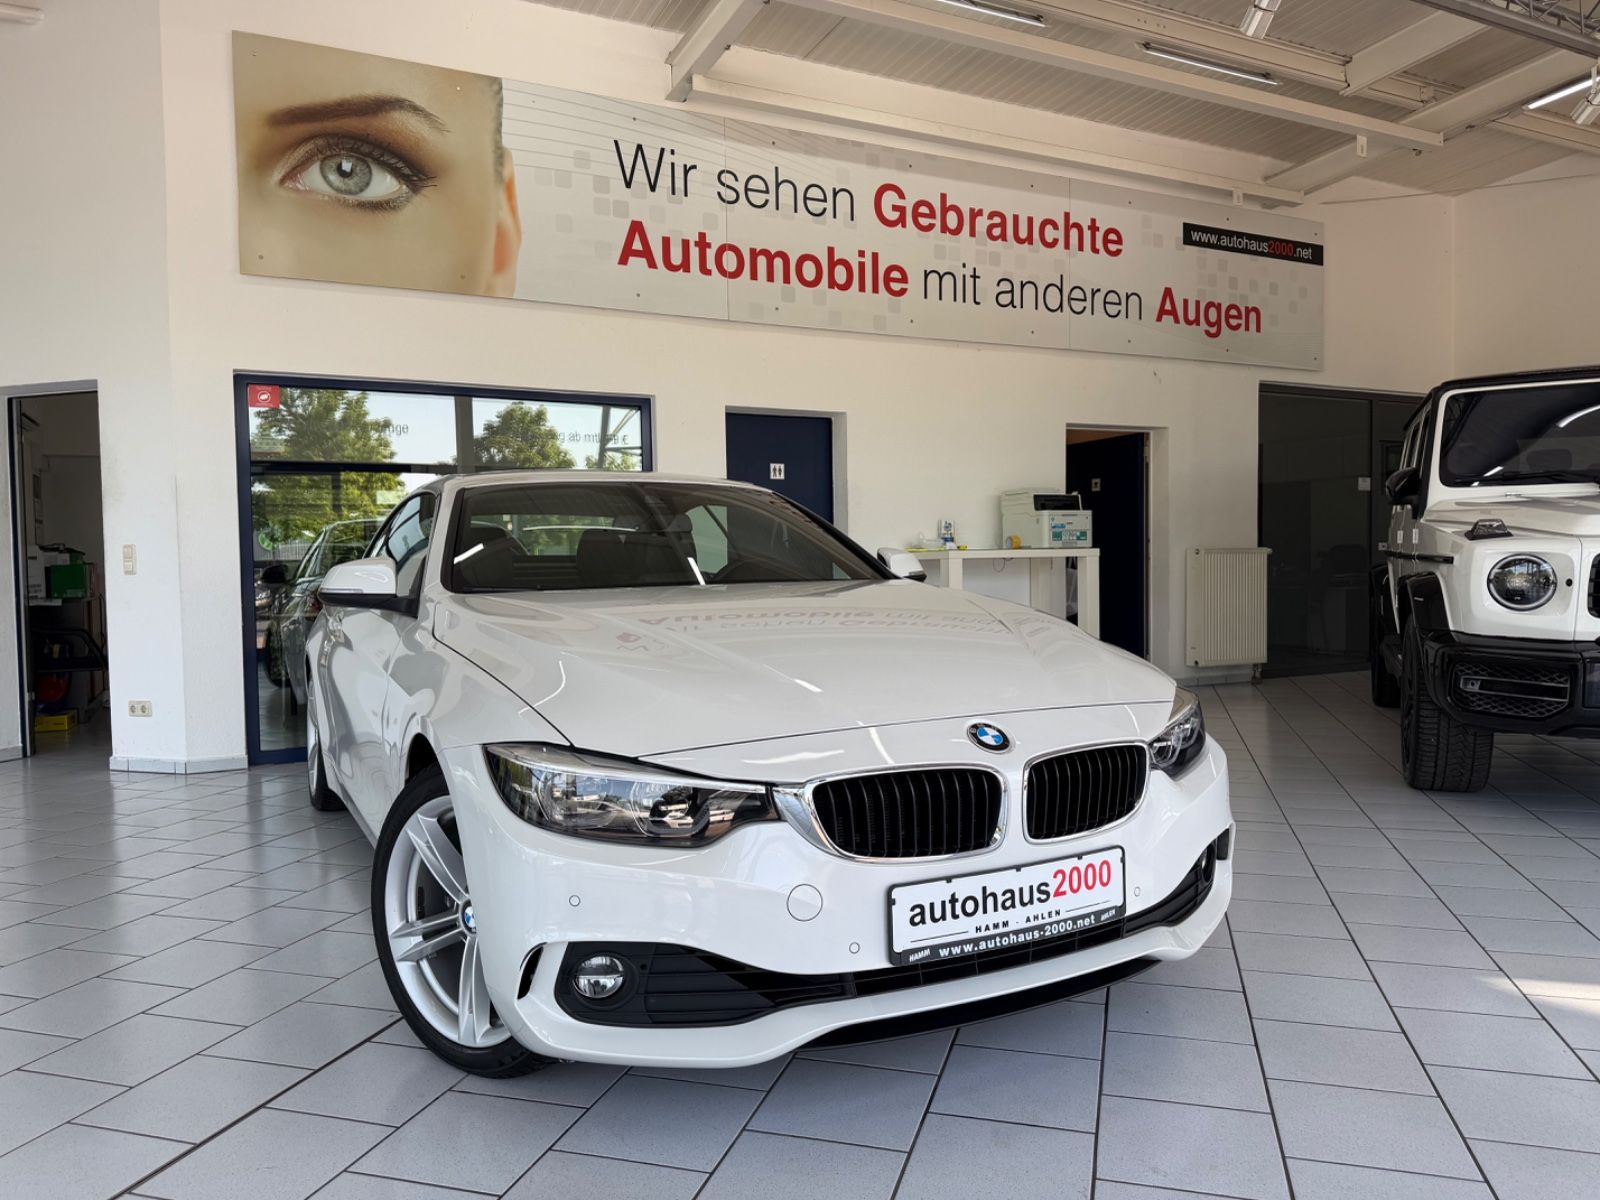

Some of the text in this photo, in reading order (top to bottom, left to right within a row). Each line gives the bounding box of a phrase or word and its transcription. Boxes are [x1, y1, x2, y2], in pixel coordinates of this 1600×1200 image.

[614, 139, 1124, 258] Wir sehen Gebrauchte
[1190, 229, 1313, 260] www.autohaus2000.net
[617, 218, 1262, 338] Automobile mit anderen Augen
[909, 859, 1113, 927] autohaus2000
[975, 920, 1010, 934] HAMM
[1025, 909, 1062, 924] AHLEN
[909, 947, 931, 963] HAMM
[938, 914, 1095, 958] www.autohaus-2000.net
